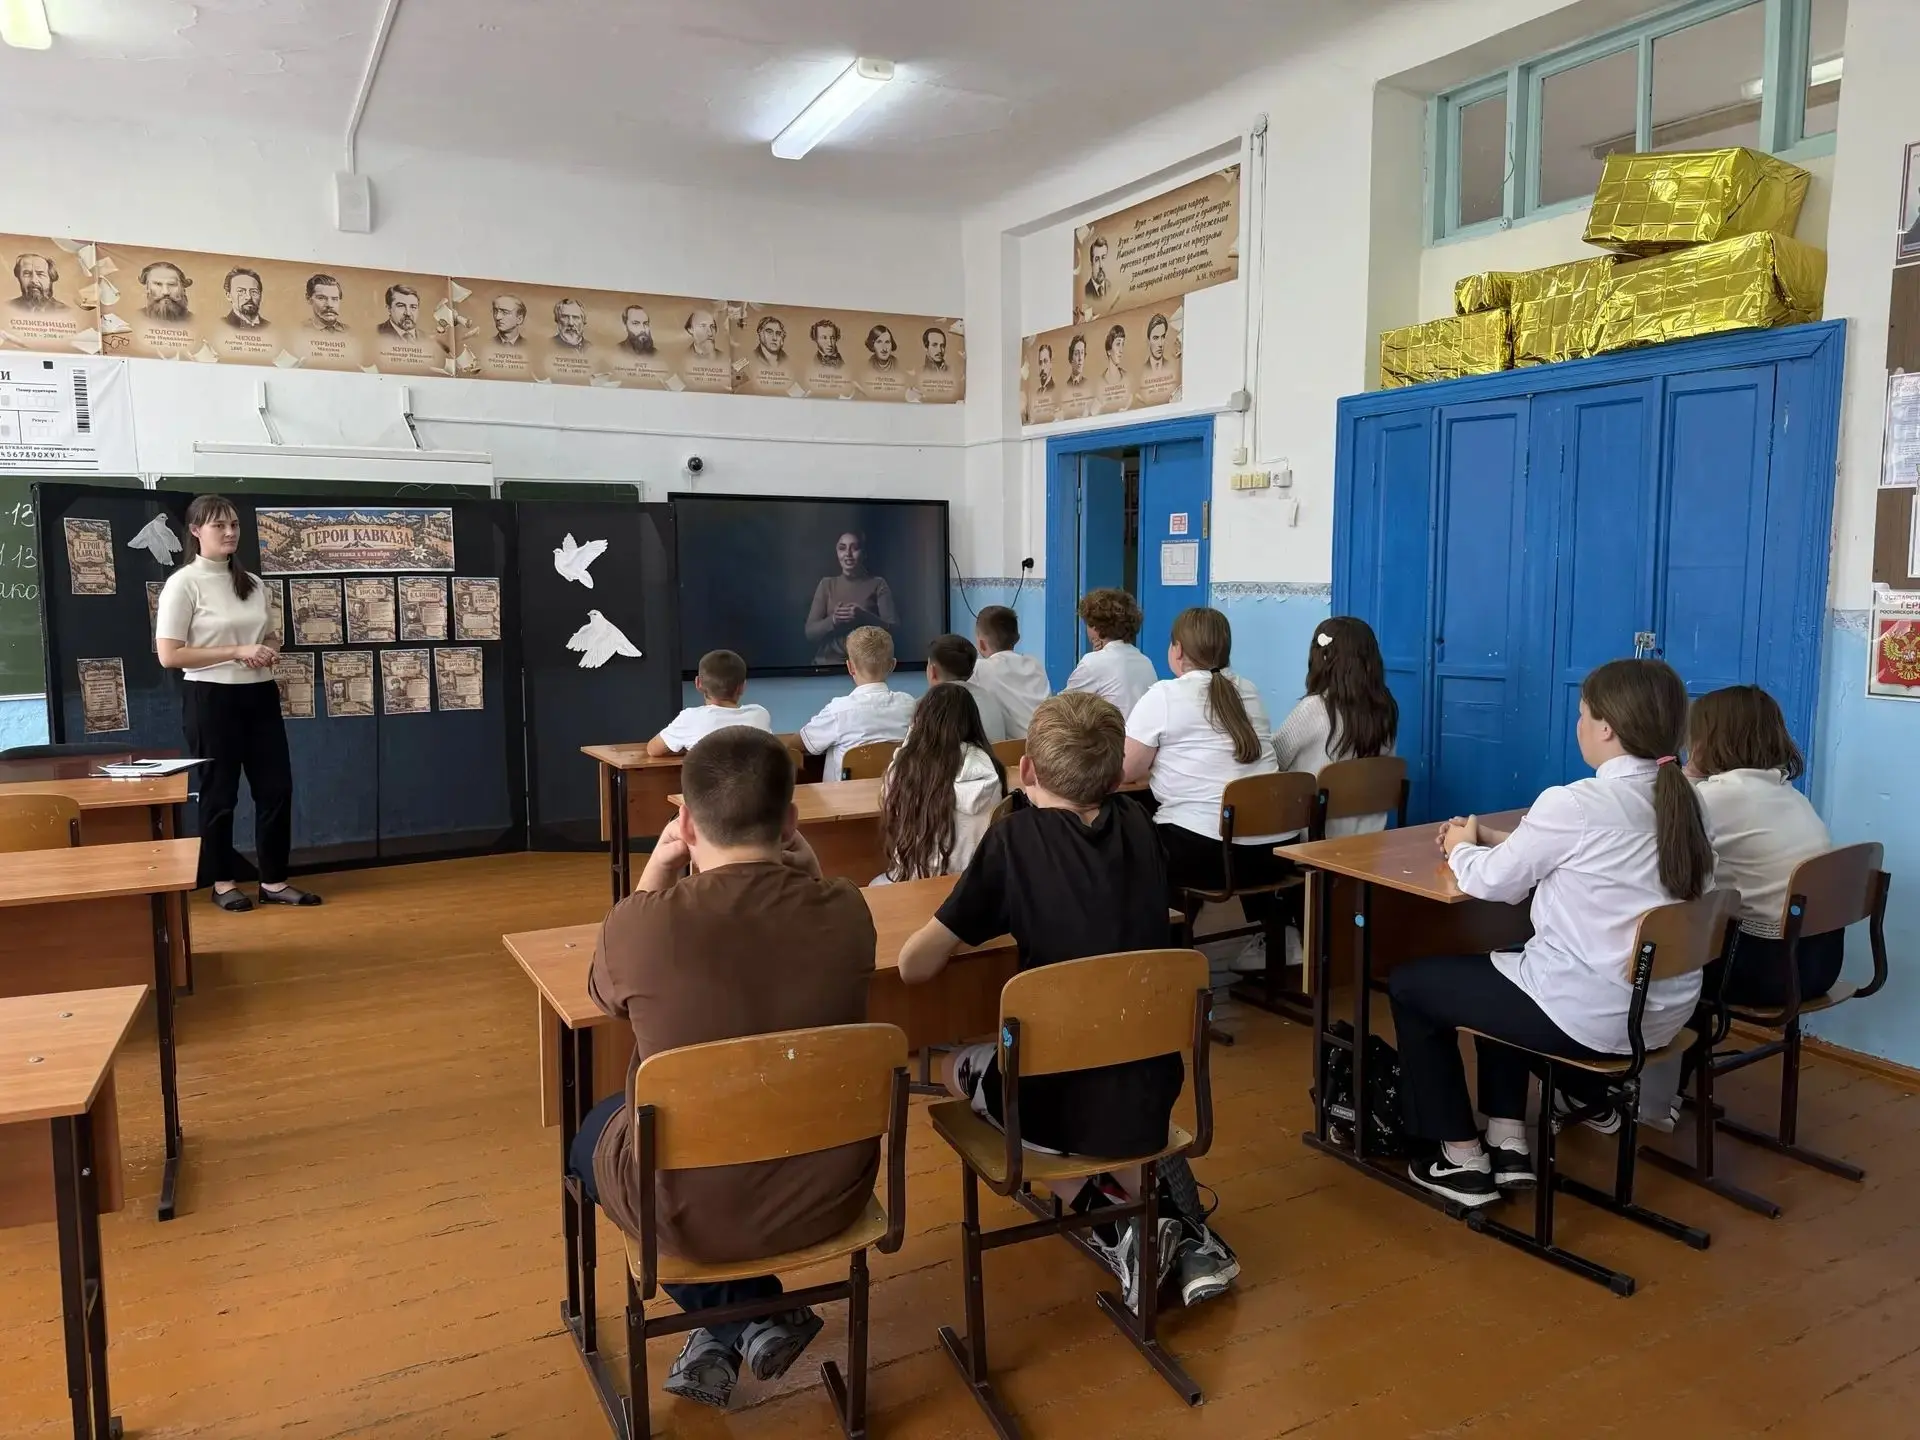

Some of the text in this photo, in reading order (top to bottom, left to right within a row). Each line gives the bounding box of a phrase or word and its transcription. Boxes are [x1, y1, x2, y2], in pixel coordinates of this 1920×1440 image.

[1163, 202, 1188, 220] история
[1190, 214, 1229, 233] сбережение
[1191, 230, 1223, 248] праздным
[10, 319, 76, 329] СОЛЖЕНИЦЫН
[148, 328, 189, 337] ТОЛСТОЙ
[310, 340, 346, 348] ГОРЬКИЙ
[306, 528, 412, 548] ГЕРОИ КАВКАЗА
[79, 541, 101, 550] ГЕРОИ
